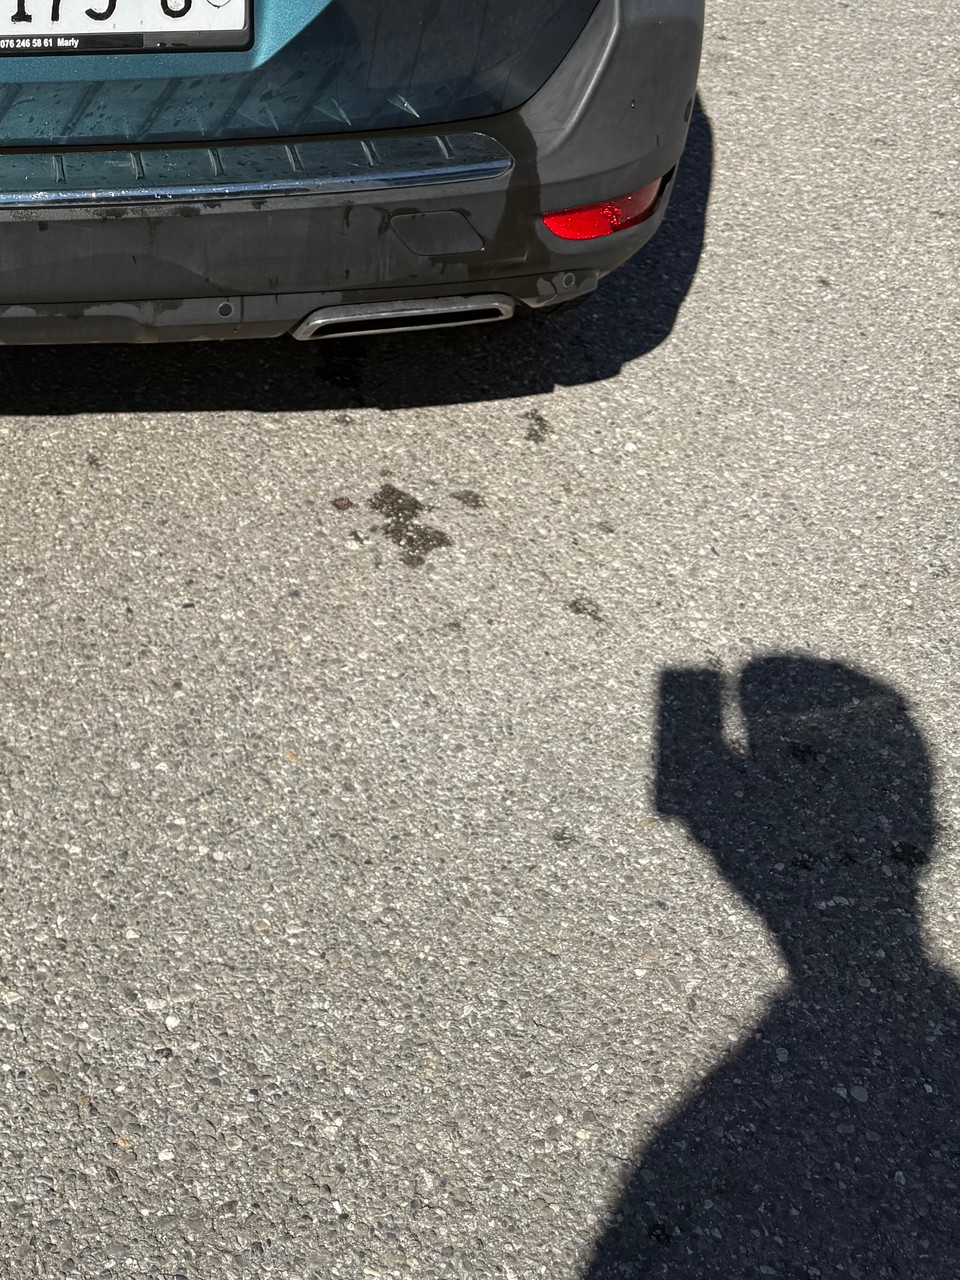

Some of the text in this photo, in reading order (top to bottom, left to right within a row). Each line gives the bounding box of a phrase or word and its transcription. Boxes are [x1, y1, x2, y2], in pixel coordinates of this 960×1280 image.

[0, 39, 15, 48] 076
[16, 39, 31, 48] 246
[32, 38, 42, 48] 58
[43, 38, 53, 47] 61
[57, 37, 79, 48] Marly
